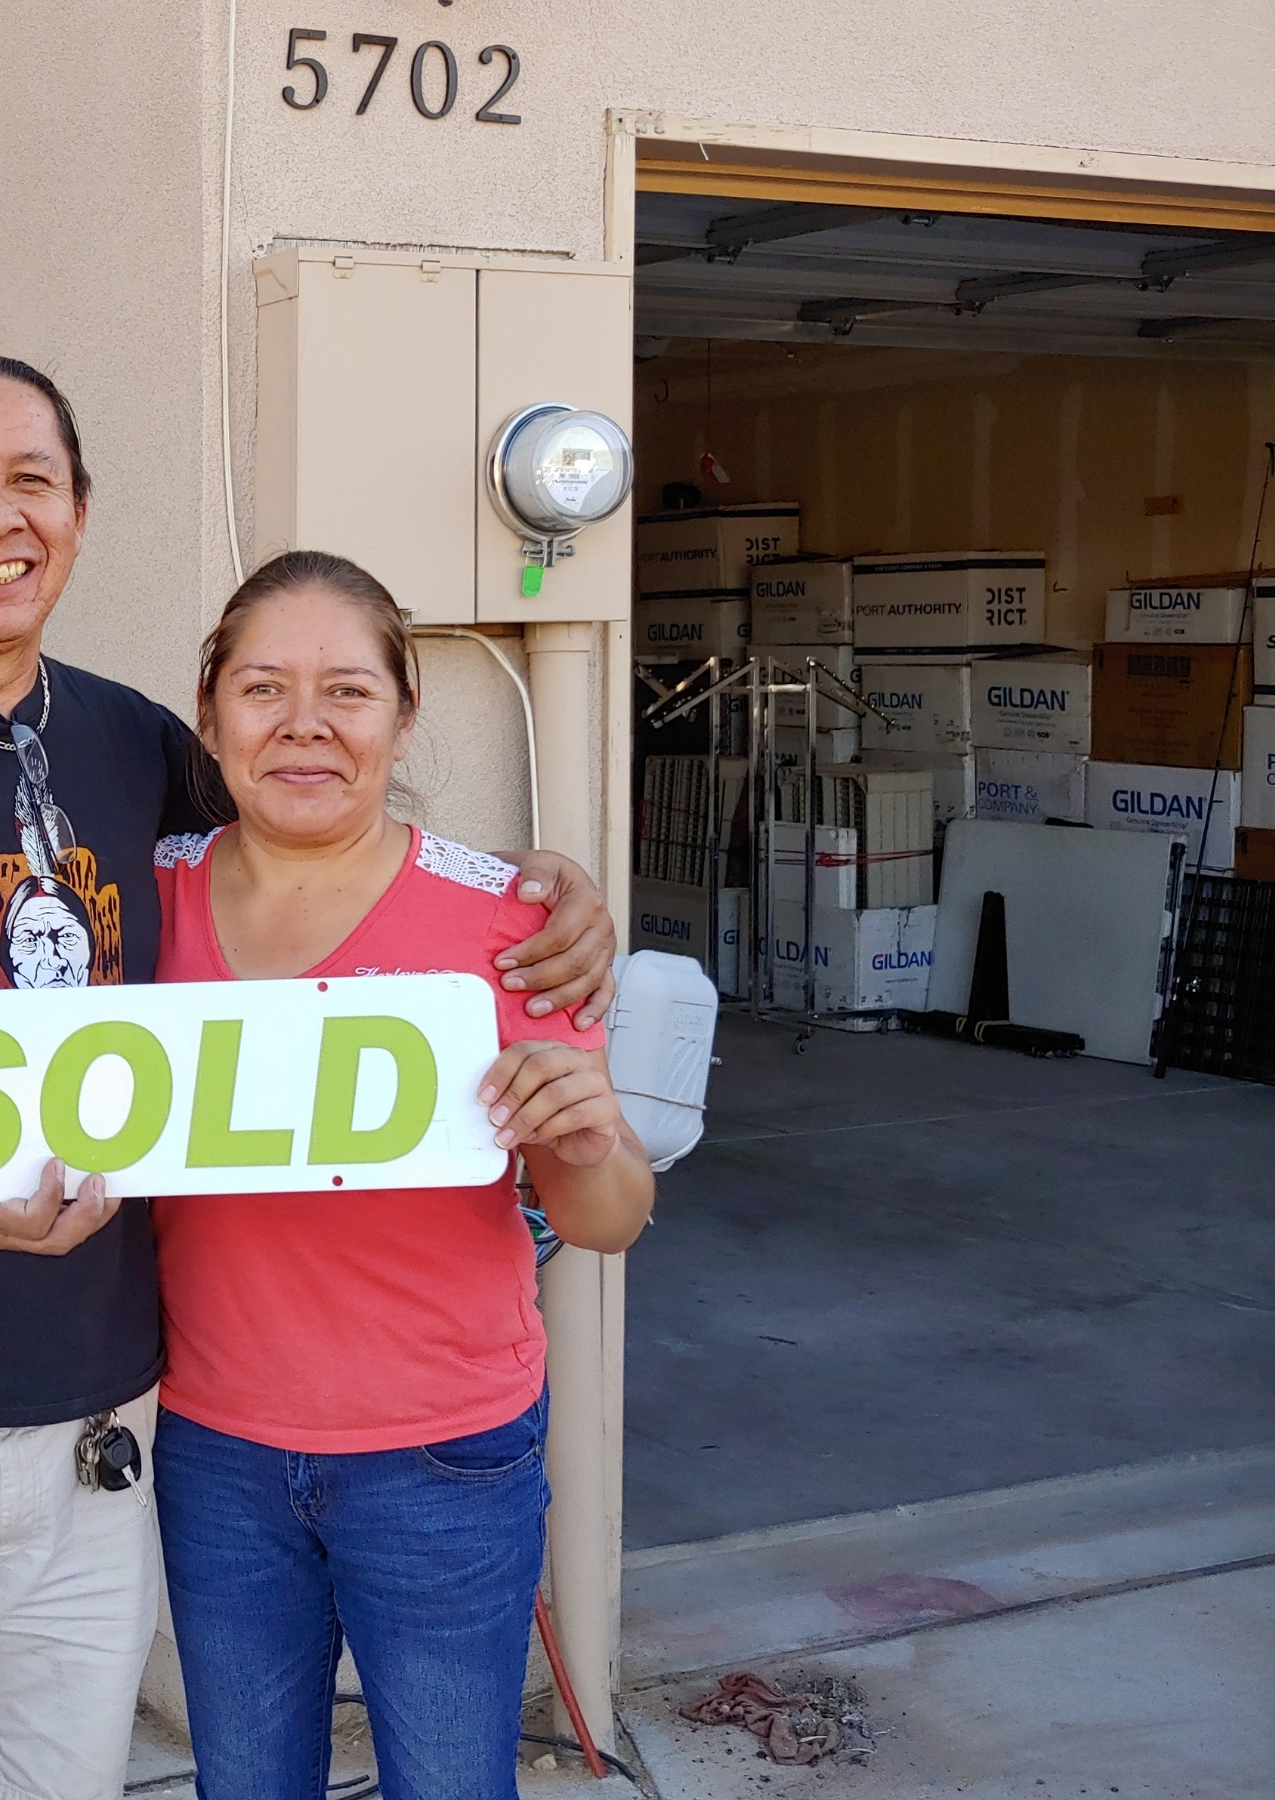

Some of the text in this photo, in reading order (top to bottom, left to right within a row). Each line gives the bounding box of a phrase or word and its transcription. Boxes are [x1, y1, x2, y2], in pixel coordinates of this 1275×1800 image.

[282, 28, 521, 124] 5702
[660, 547, 717, 561] AUTHORITY
[756, 581, 805, 598] GILDAN
[986, 587, 1026, 605] DIST
[856, 603, 962, 616] PORT AUTHORITY
[1130, 592, 1201, 610] GILDAN
[986, 608, 1026, 626] RICT
[647, 623, 702, 641] GILDAN
[867, 692, 922, 710] GILDAN
[988, 686, 1066, 711] GILDAN
[978, 781, 1037, 800] PORT &
[978, 798, 1038, 815] COMPANY
[1112, 789, 1203, 820] GILDAN
[641, 913, 690, 941] GILDAN
[872, 951, 932, 970] GILDAN
